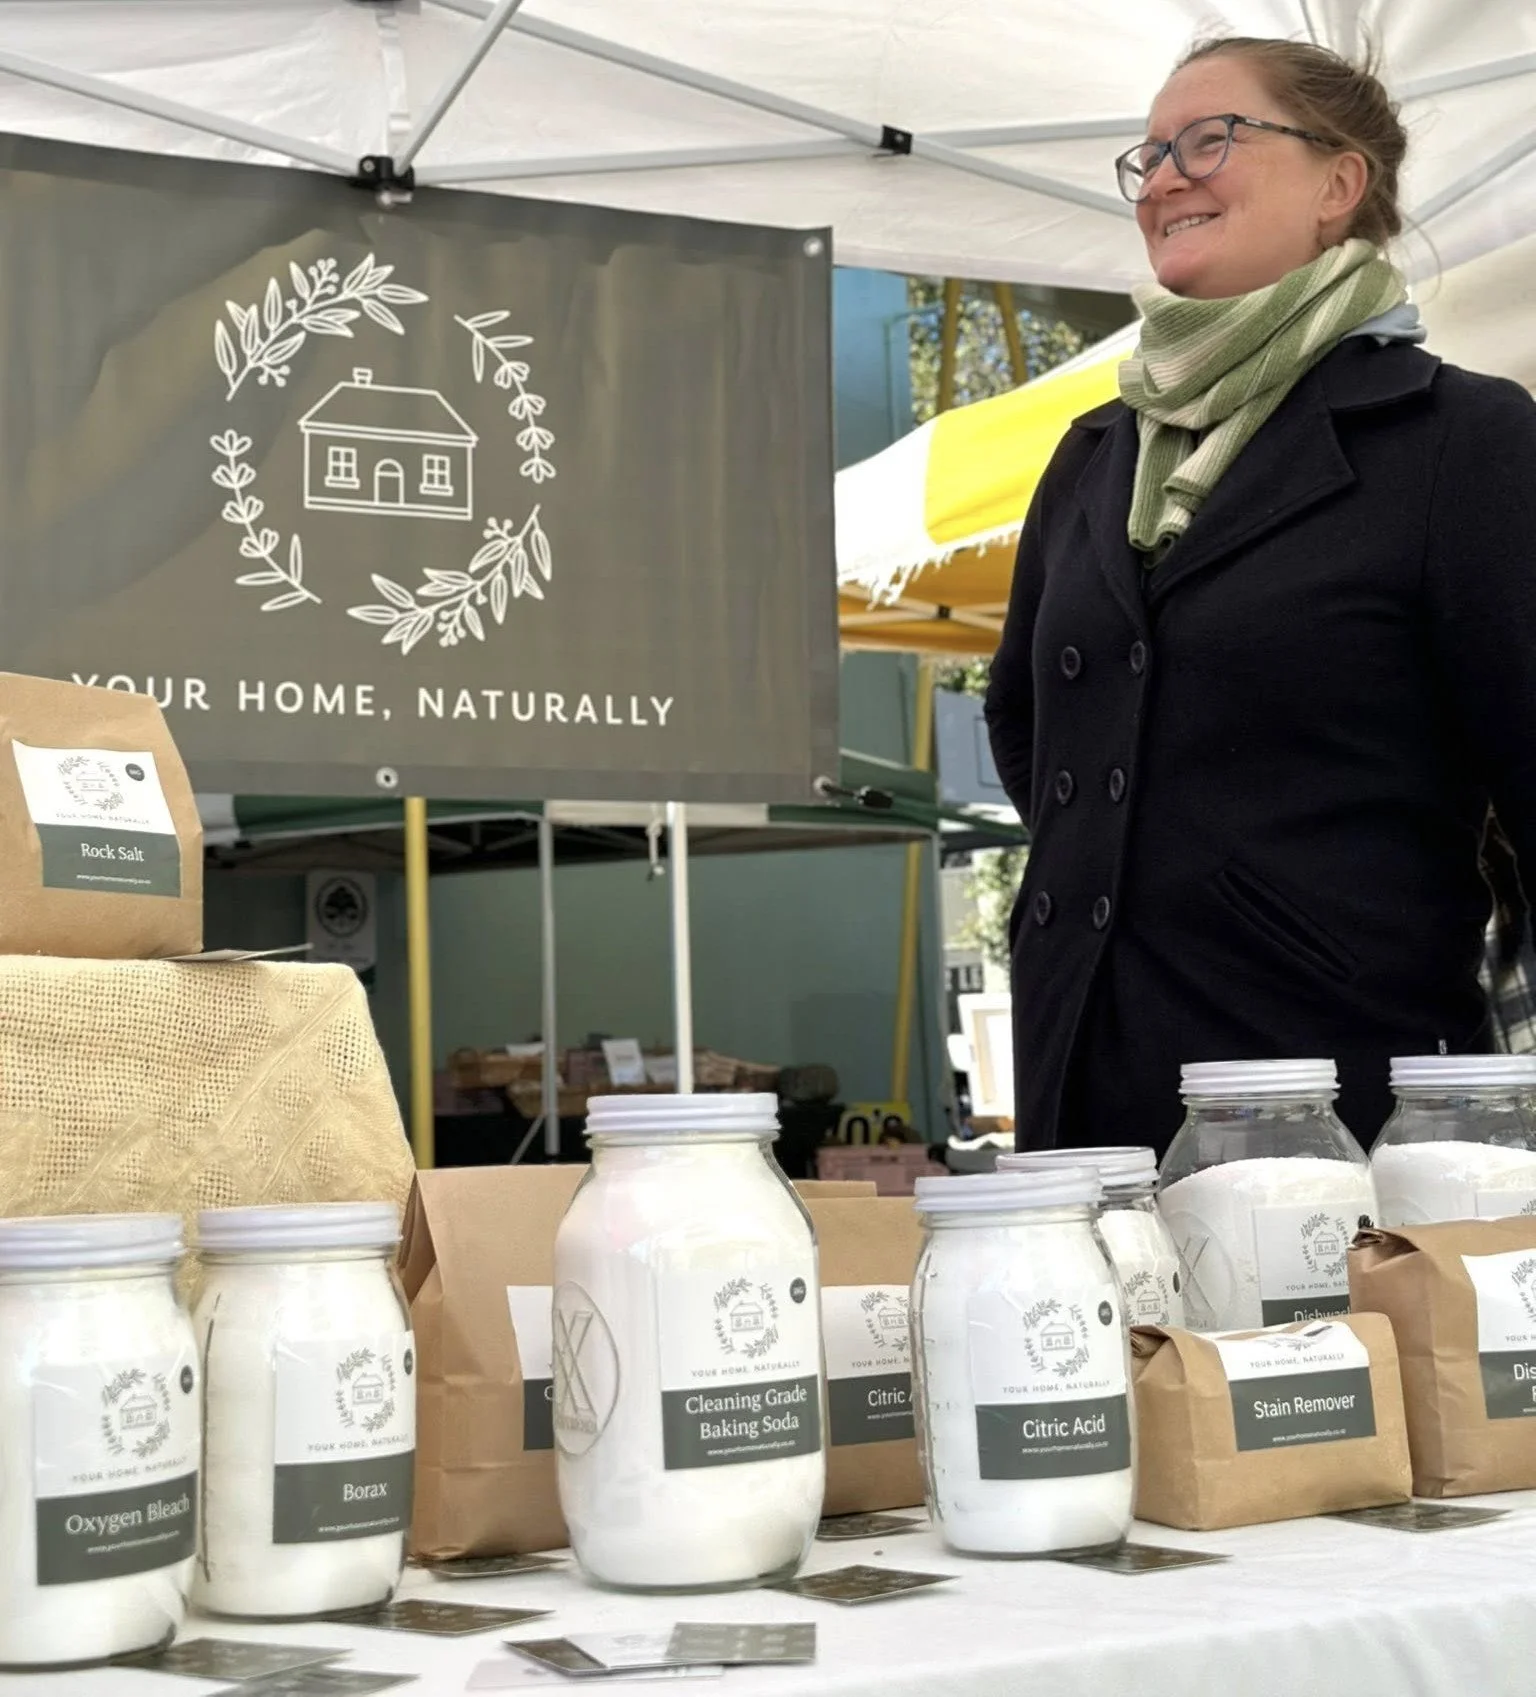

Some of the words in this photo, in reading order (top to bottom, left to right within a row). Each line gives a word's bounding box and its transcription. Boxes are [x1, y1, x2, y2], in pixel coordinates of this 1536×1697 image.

[237, 680, 392, 720] HOME,
[417, 687, 674, 726] NATURALLY
[81, 843, 116, 860] Rock
[118, 846, 145, 862] Salt
[1513, 1363, 1536, 1380] Dis
[685, 1392, 762, 1414] Cleaning
[765, 1384, 808, 1406] Grade
[868, 1387, 906, 1407] Citric
[1253, 1398, 1292, 1419] Stain
[1294, 1395, 1356, 1414] Remover
[700, 1419, 760, 1440] Baking
[762, 1411, 800, 1433] Soda
[1023, 1417, 1069, 1439] Citric
[1073, 1412, 1106, 1436] Acid
[343, 1482, 388, 1502] Borax
[65, 1513, 142, 1537] Oxygen
[147, 1493, 190, 1522] Bleach
